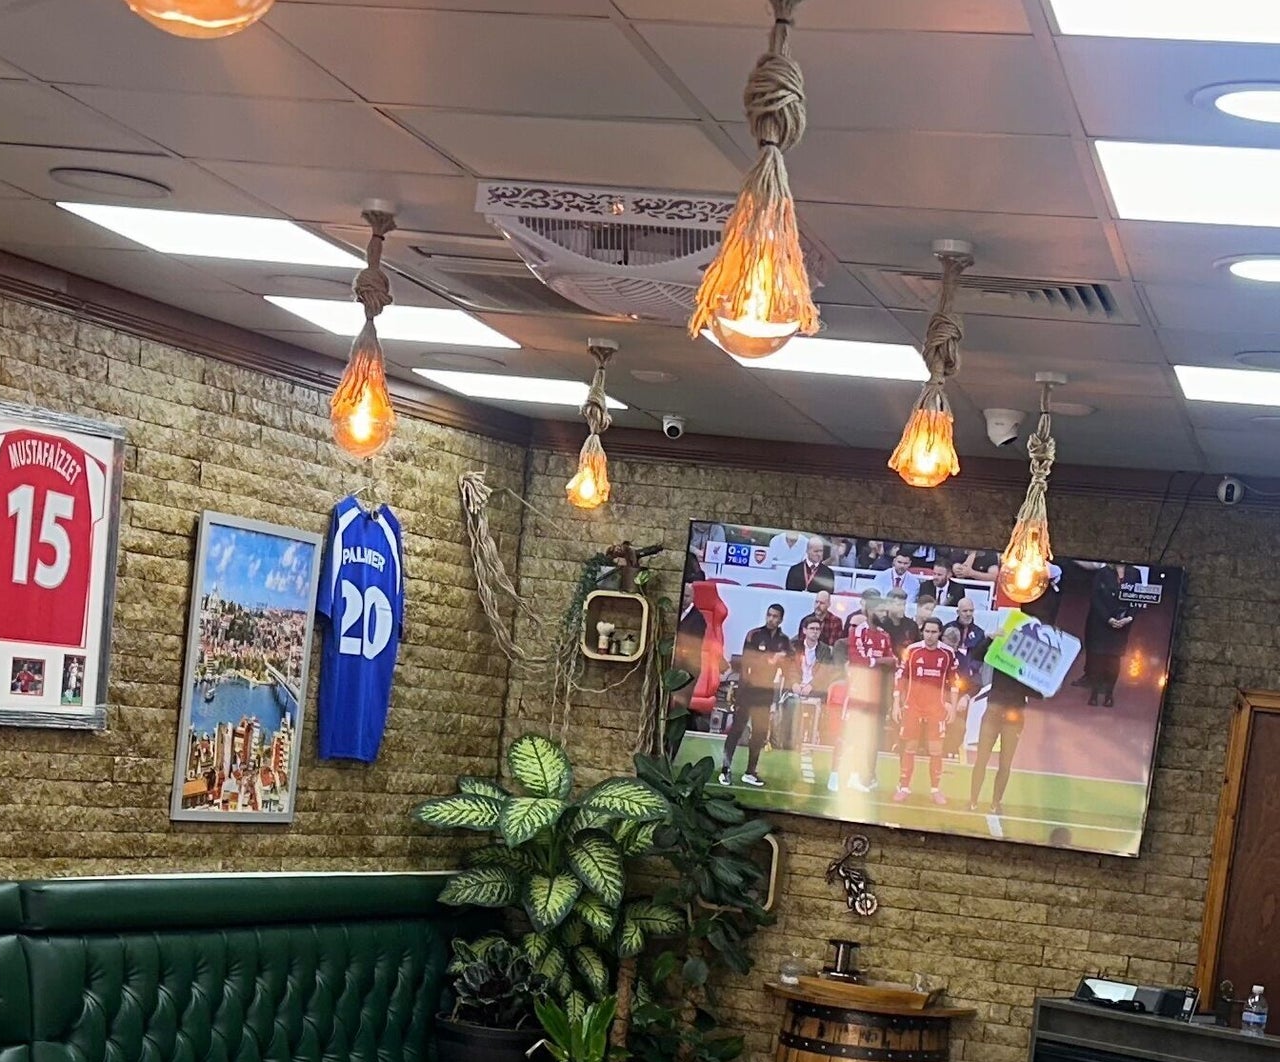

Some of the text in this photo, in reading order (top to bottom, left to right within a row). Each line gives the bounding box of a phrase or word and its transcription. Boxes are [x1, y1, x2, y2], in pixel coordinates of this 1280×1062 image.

[7, 483, 75, 589] 15
[342, 546, 386, 573] PALMER
[1120, 582, 1135, 591] sky
[339, 579, 393, 660] 20
